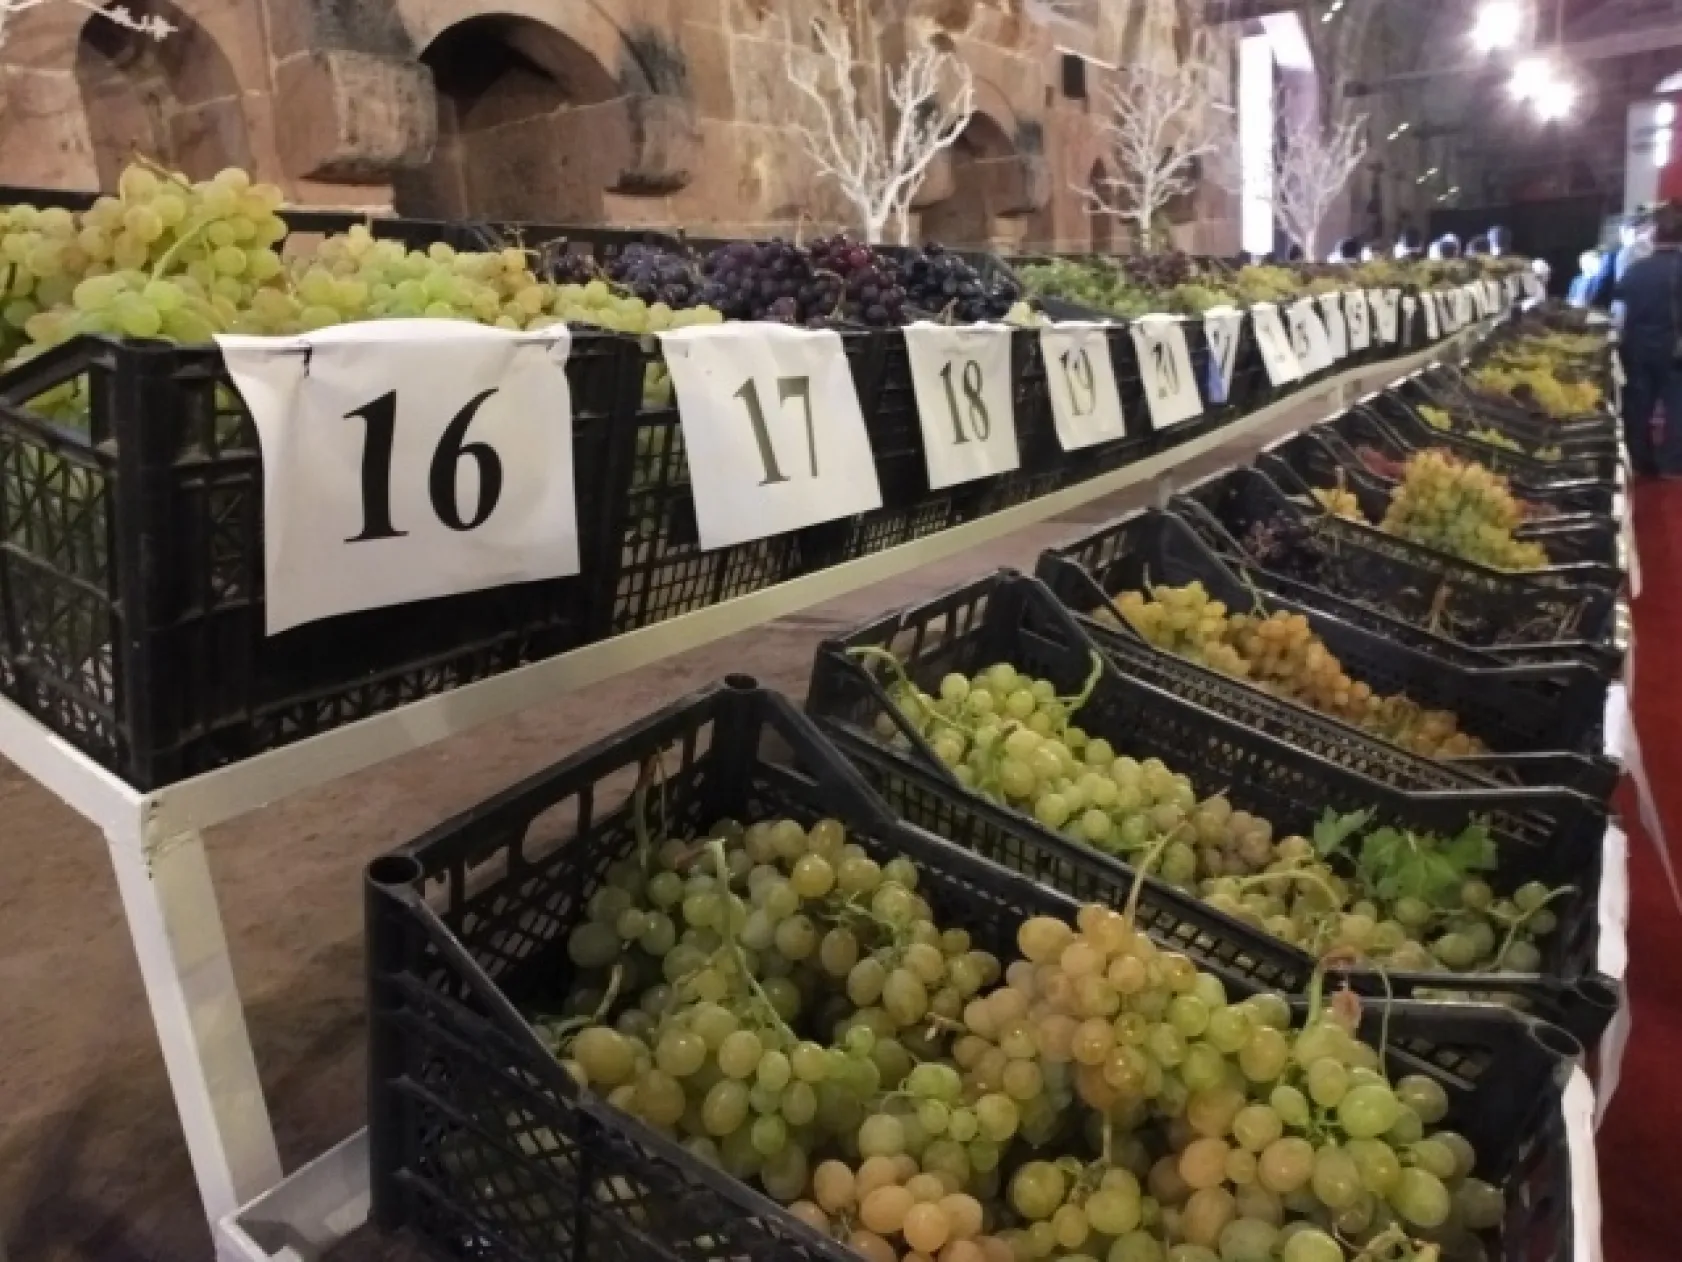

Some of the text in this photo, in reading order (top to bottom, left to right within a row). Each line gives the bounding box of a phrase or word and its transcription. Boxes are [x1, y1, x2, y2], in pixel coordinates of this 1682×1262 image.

[939, 360, 990, 445] 18
[1058, 347, 1097, 416] 19
[342, 387, 504, 543] 16
[733, 376, 818, 487] 17
